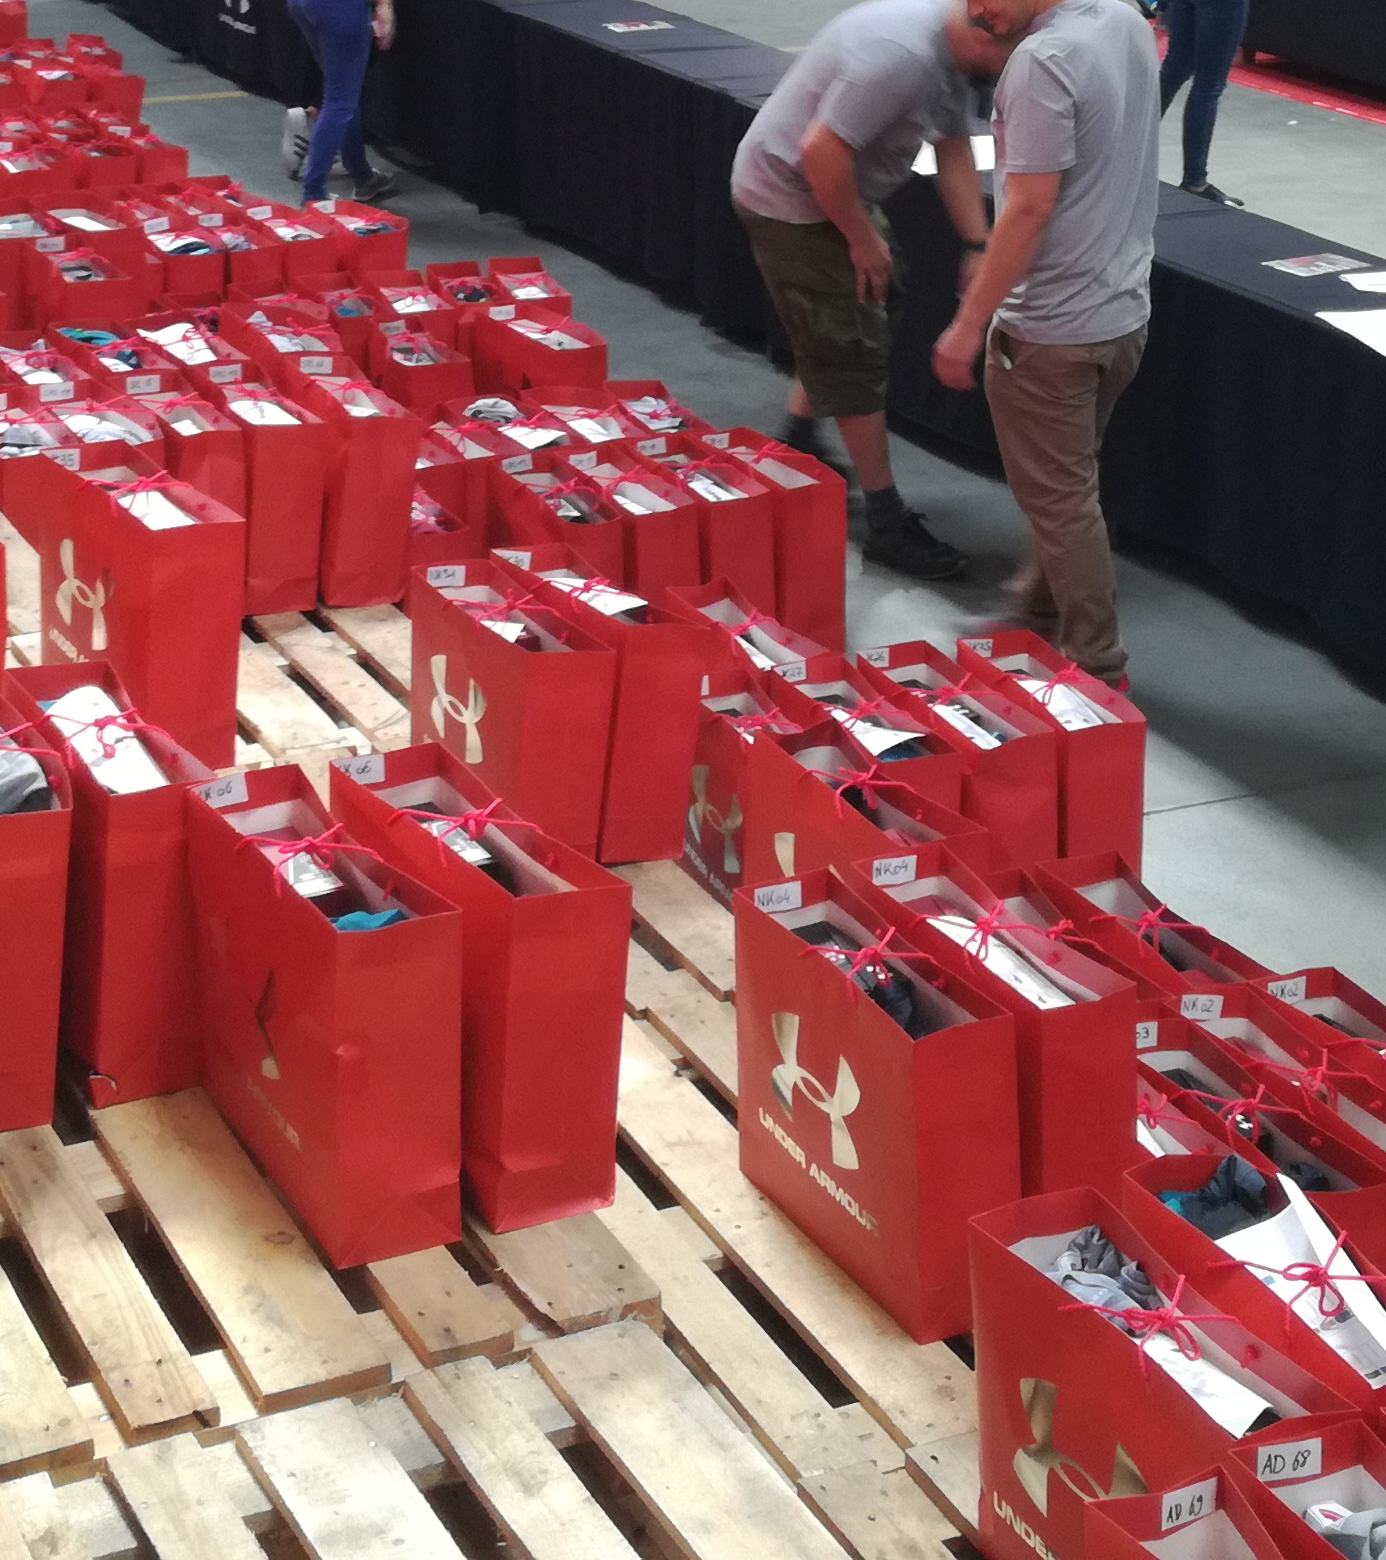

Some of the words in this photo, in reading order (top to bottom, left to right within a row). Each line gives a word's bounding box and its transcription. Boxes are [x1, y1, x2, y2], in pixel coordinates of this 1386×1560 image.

[758, 1106, 807, 1169] UNDER
[1261, 1453, 1286, 1476] AD
[1292, 1448, 1311, 1472] 68
[1166, 1502, 1182, 1524] AD
